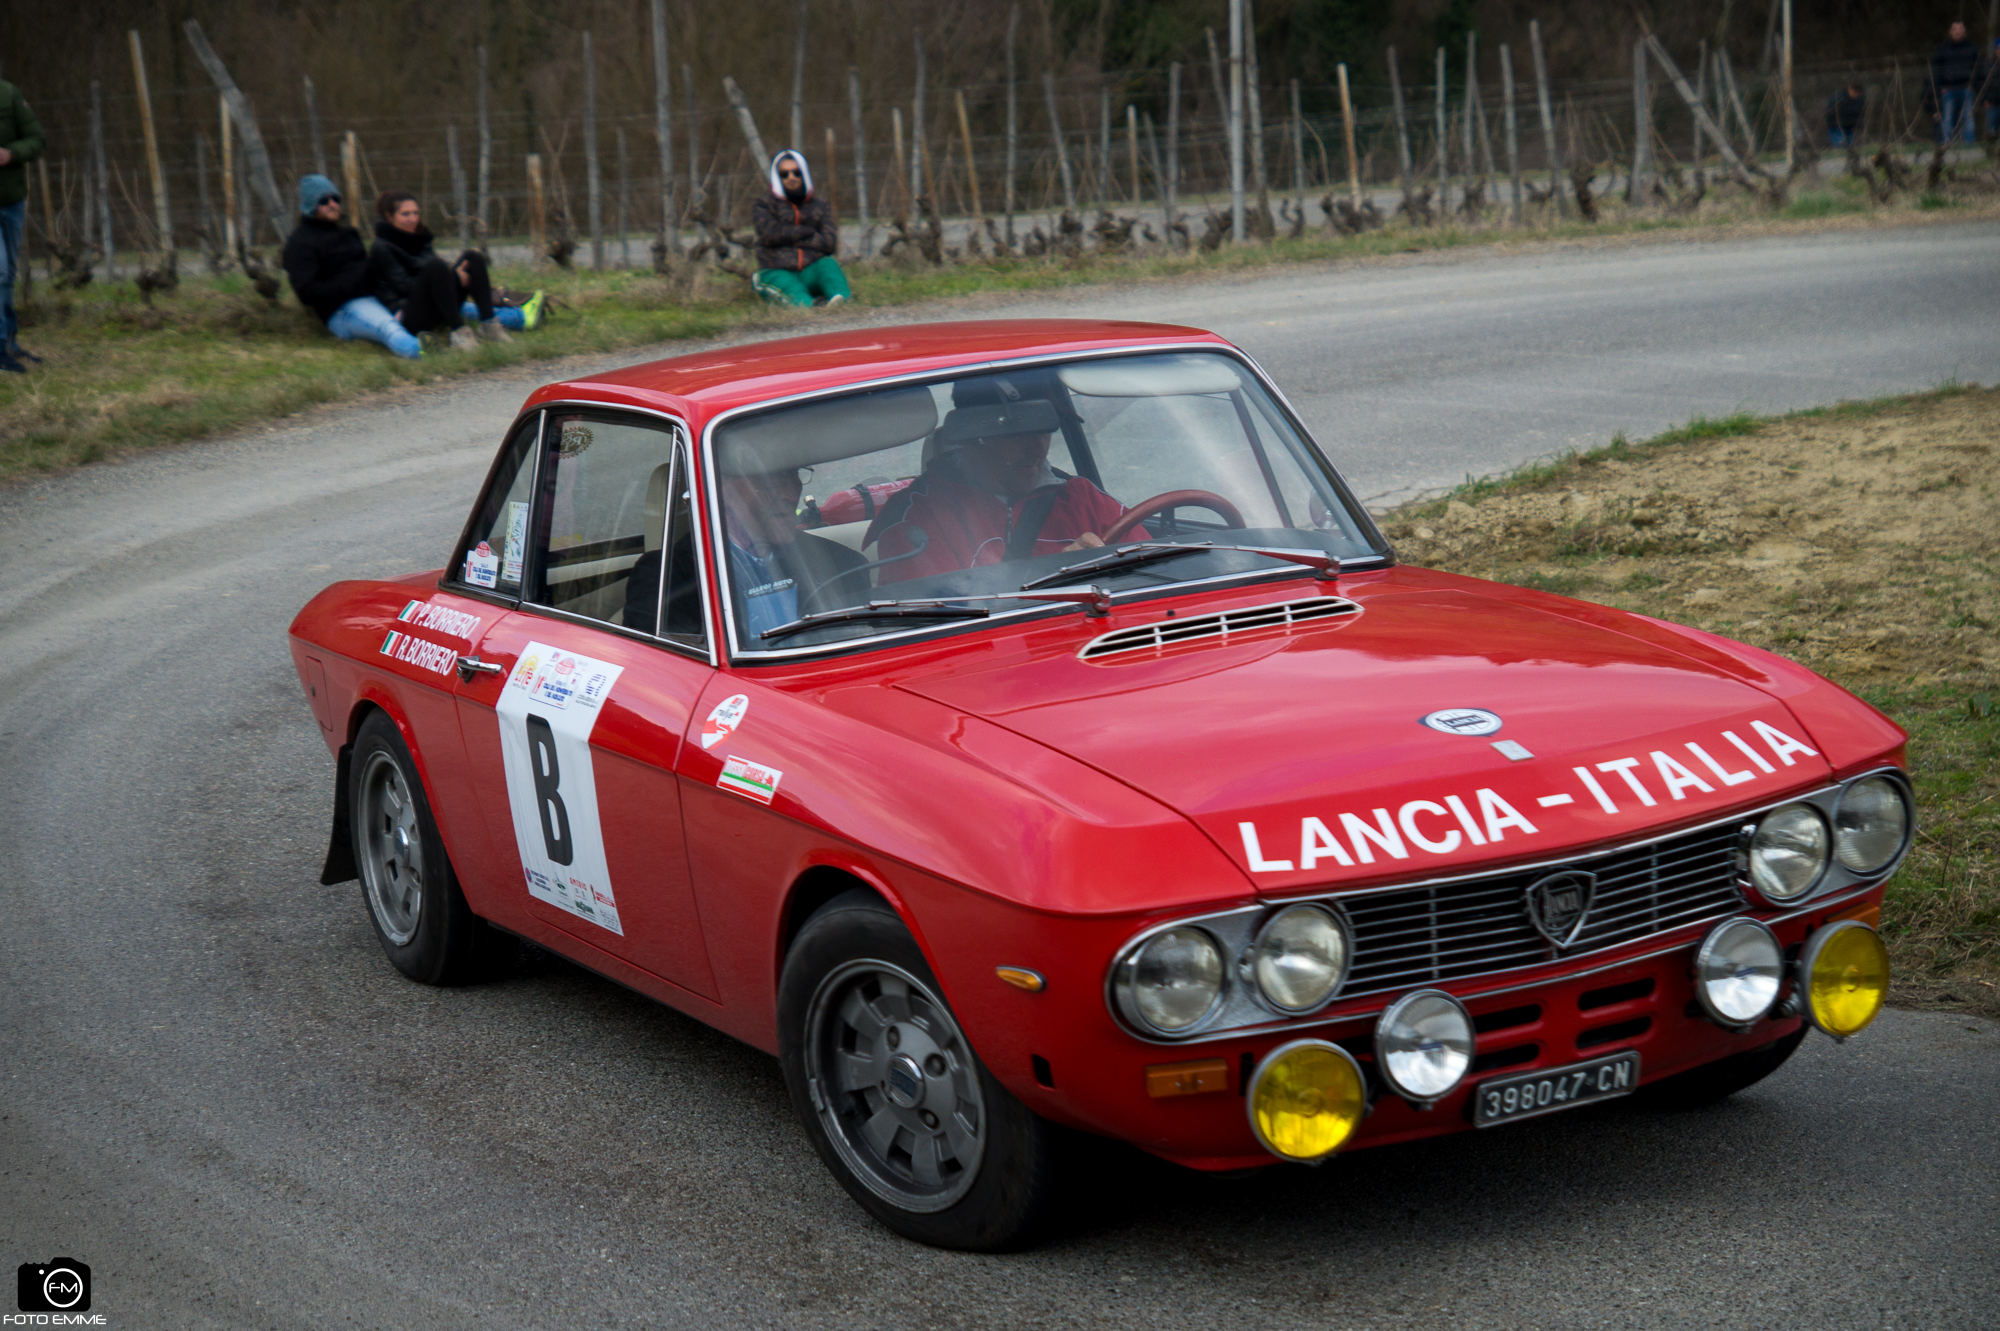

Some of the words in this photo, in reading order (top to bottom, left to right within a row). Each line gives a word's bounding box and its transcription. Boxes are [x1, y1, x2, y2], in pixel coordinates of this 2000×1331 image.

[525, 712, 574, 867] B
[1237, 787, 1539, 873] LANCIA
[1573, 719, 1819, 815] ITALIA
[1485, 1071, 1588, 1118] 398047
[1597, 1060, 1631, 1092] CN
